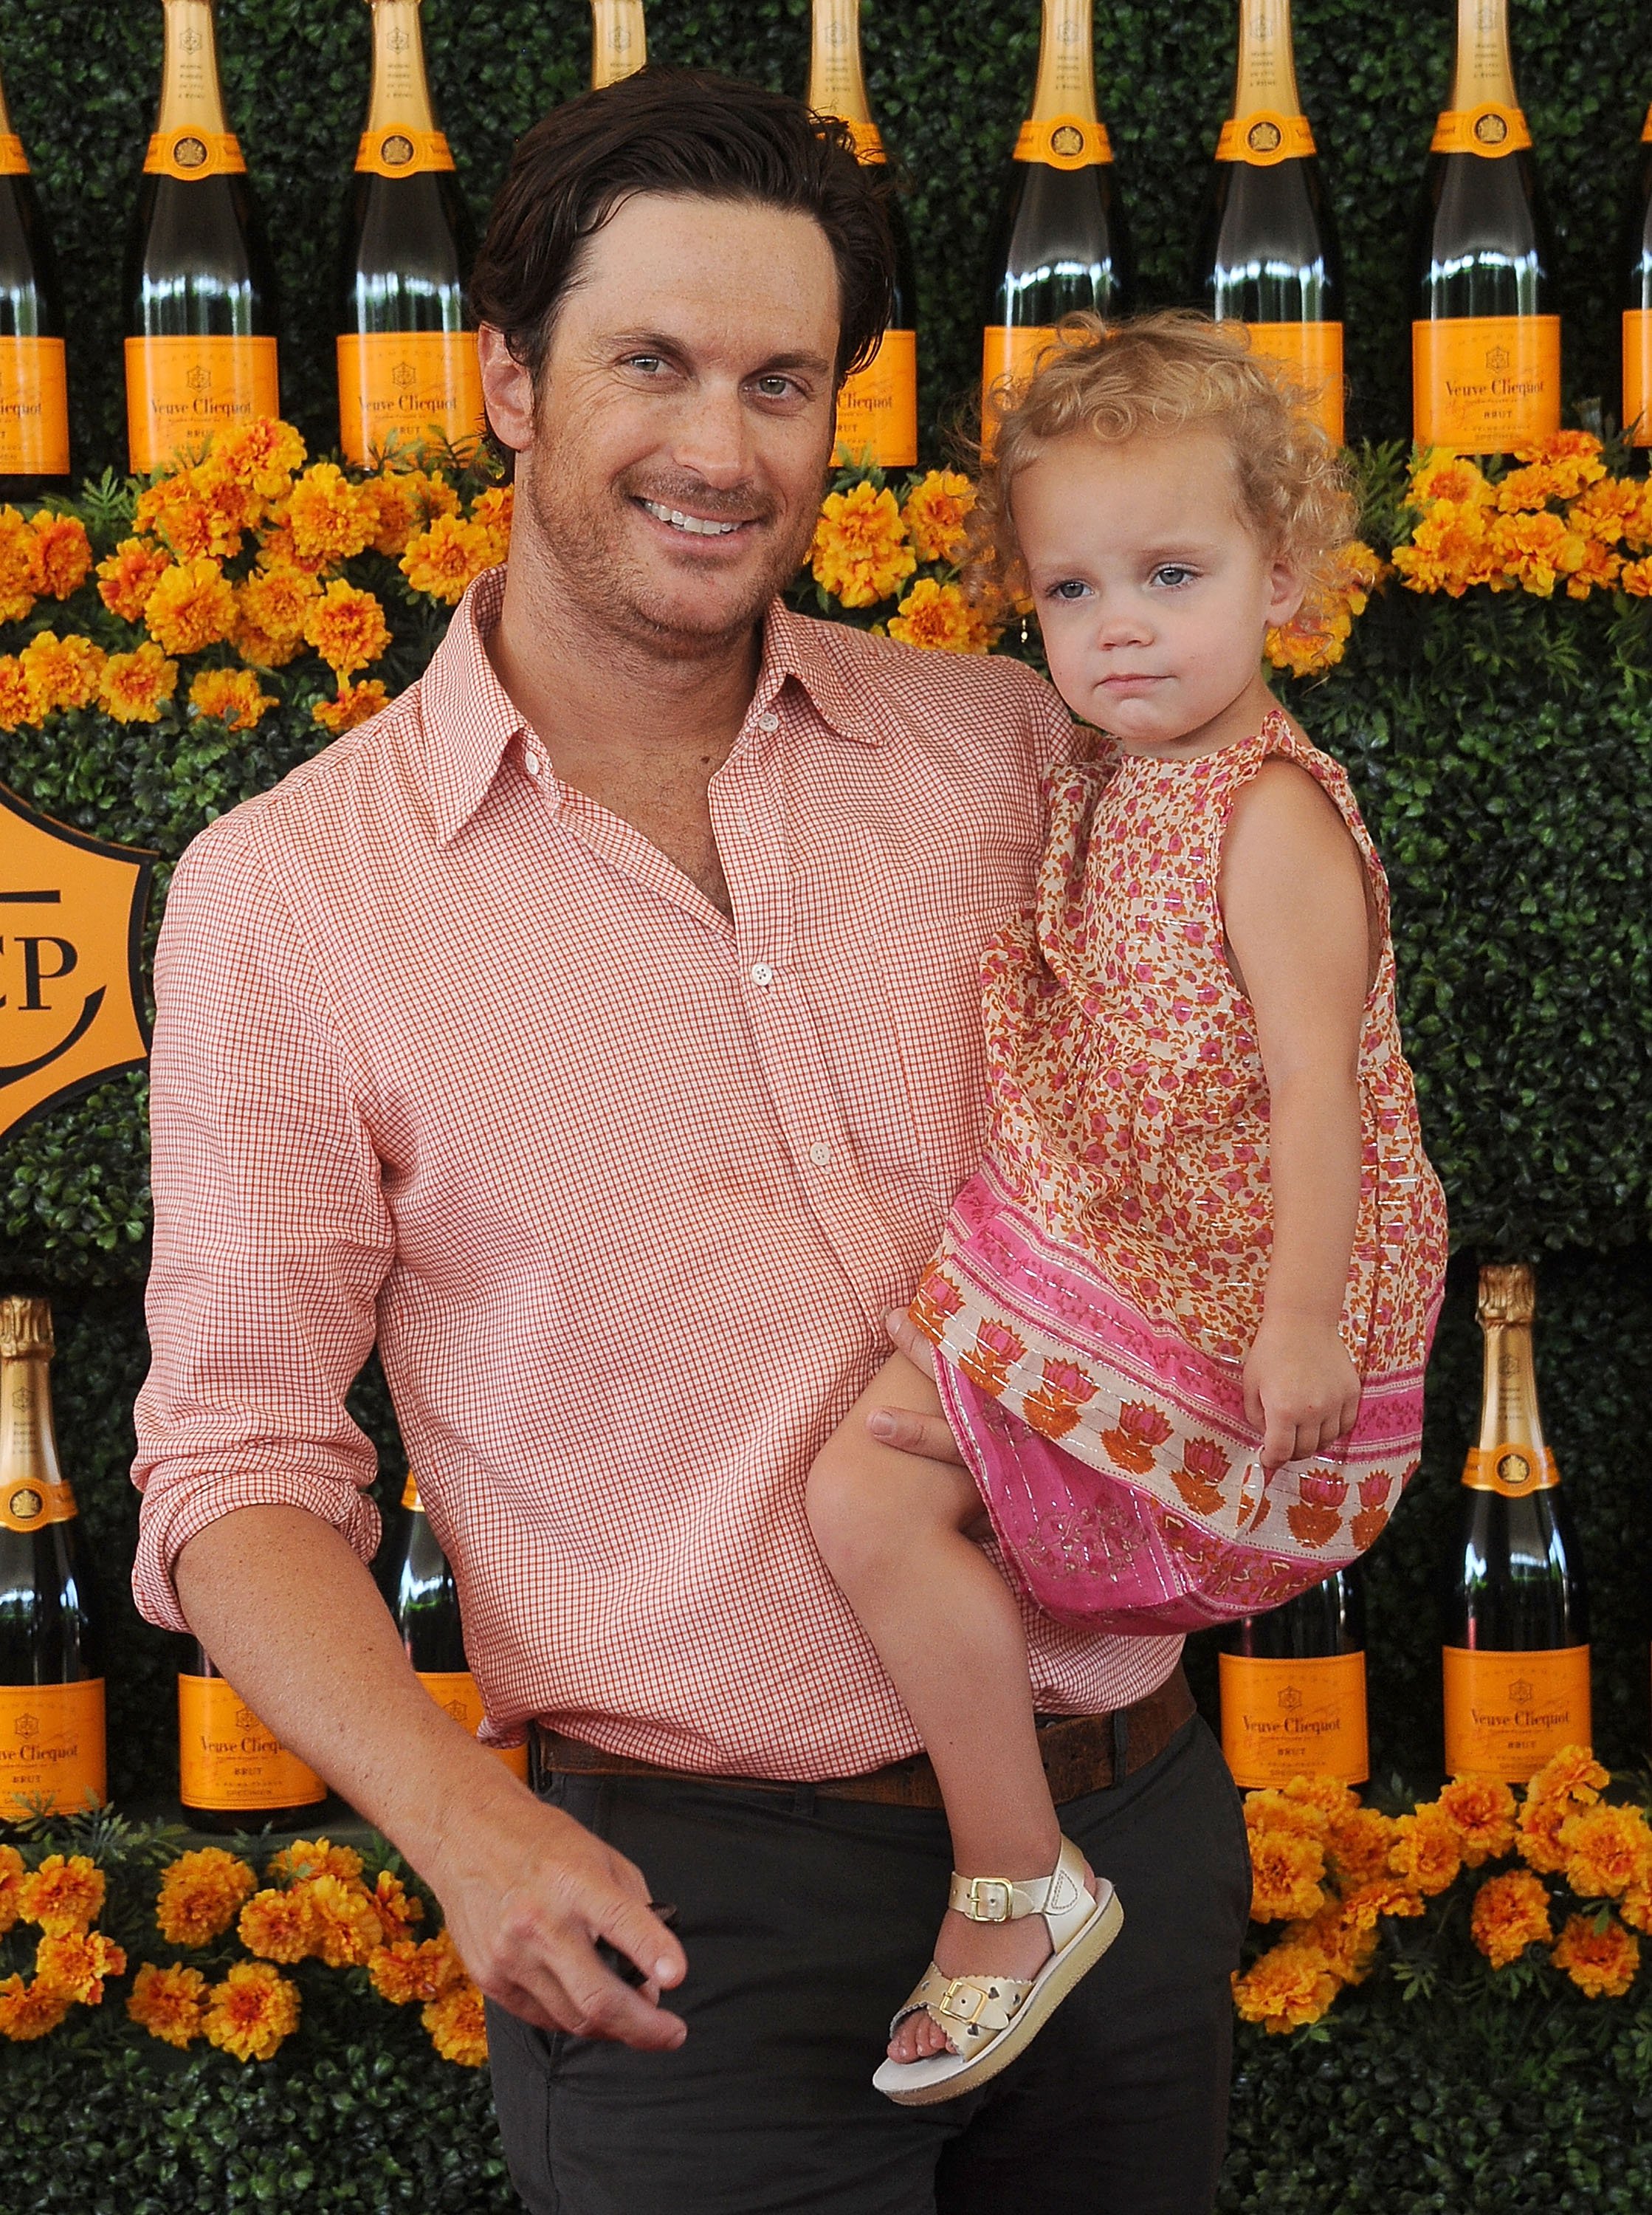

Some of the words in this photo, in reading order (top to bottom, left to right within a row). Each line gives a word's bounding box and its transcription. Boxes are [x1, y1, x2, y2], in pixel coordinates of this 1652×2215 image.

[1445, 380, 1487, 397] Veuve
[1491, 379, 1543, 397] Clicquot
[151, 399, 188, 414] Veuve
[193, 398, 251, 418] Clicquot
[357, 396, 394, 411] Veuve
[399, 394, 457, 413] Clicquot
[1484, 411, 1512, 419] BRUT
[0, 935, 78, 1010] P
[1243, 1714, 1281, 1733] Veuve
[1284, 1717, 1340, 1735] Clicquot
[1471, 1709, 1510, 1725] Veuve
[1514, 1711, 1569, 1728] Clicquot
[20, 1744, 78, 1762] Clicquot
[200, 1735, 237, 1753] Veuve
[1277, 1748, 1306, 1756] BRUT
[234, 1767, 262, 1776] BRUT
